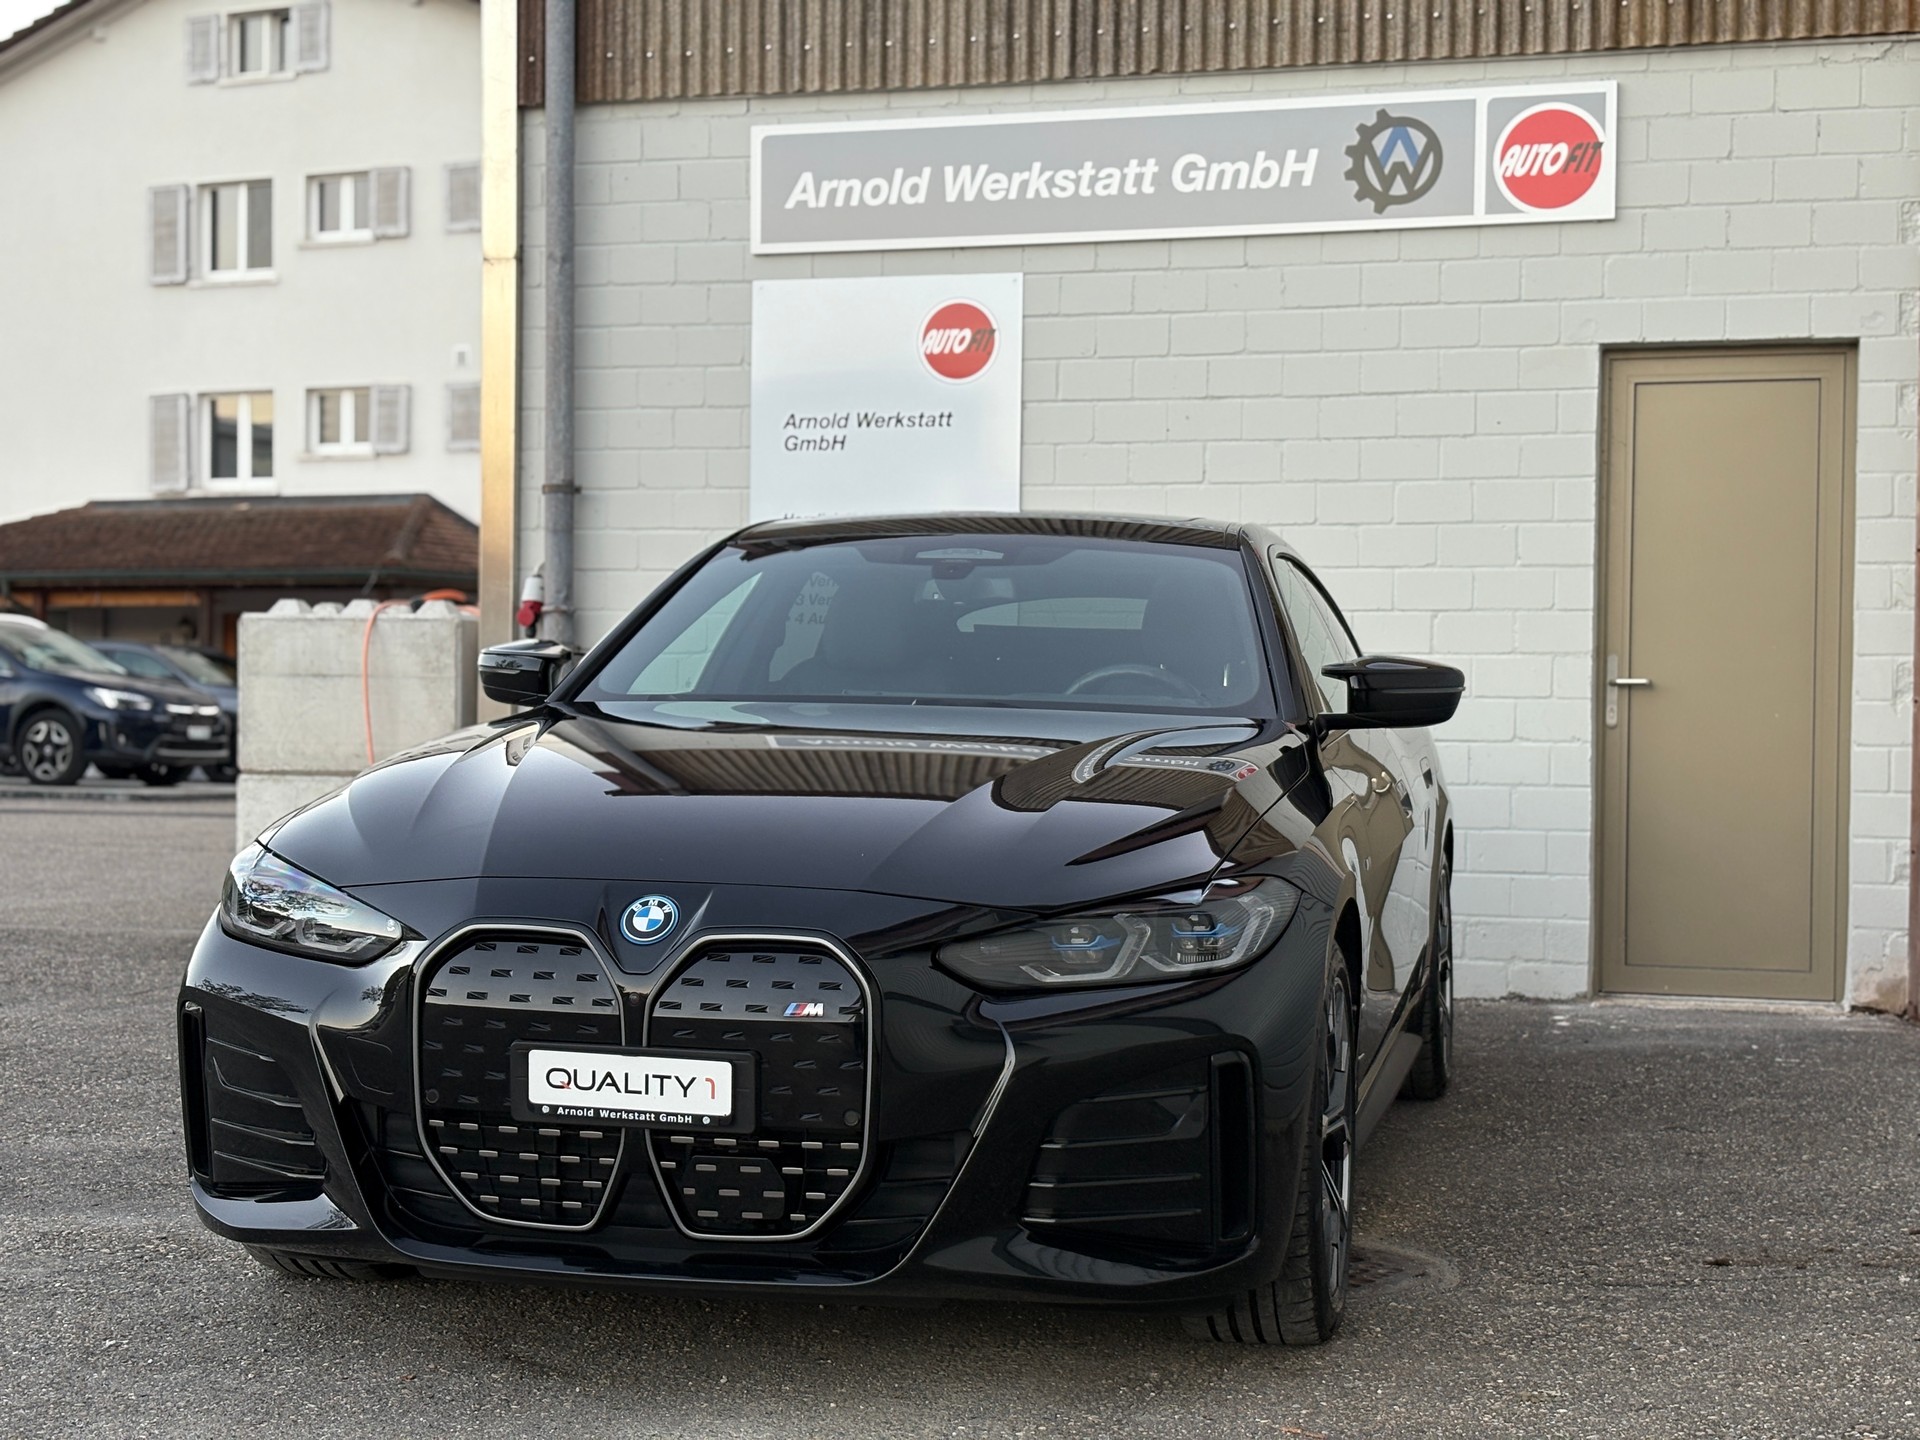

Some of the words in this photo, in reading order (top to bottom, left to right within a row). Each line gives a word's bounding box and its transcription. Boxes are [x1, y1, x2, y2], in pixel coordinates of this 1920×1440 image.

[1500, 141, 1604, 178] AUTOFIT
[784, 167, 931, 210] Arnold
[943, 157, 1159, 203] Werkstatt
[1170, 147, 1318, 193] GmbH
[922, 327, 996, 355] AUTOFIT
[783, 412, 850, 430] Arnold
[856, 411, 953, 429] Werkstatt
[783, 434, 847, 452] GmbH
[632, 899, 672, 913] BMW
[545, 1067, 697, 1098] QUALITY
[556, 1106, 594, 1118] Arnold
[599, 1109, 656, 1122] Werkstatt
[659, 1113, 693, 1124] GmbH
